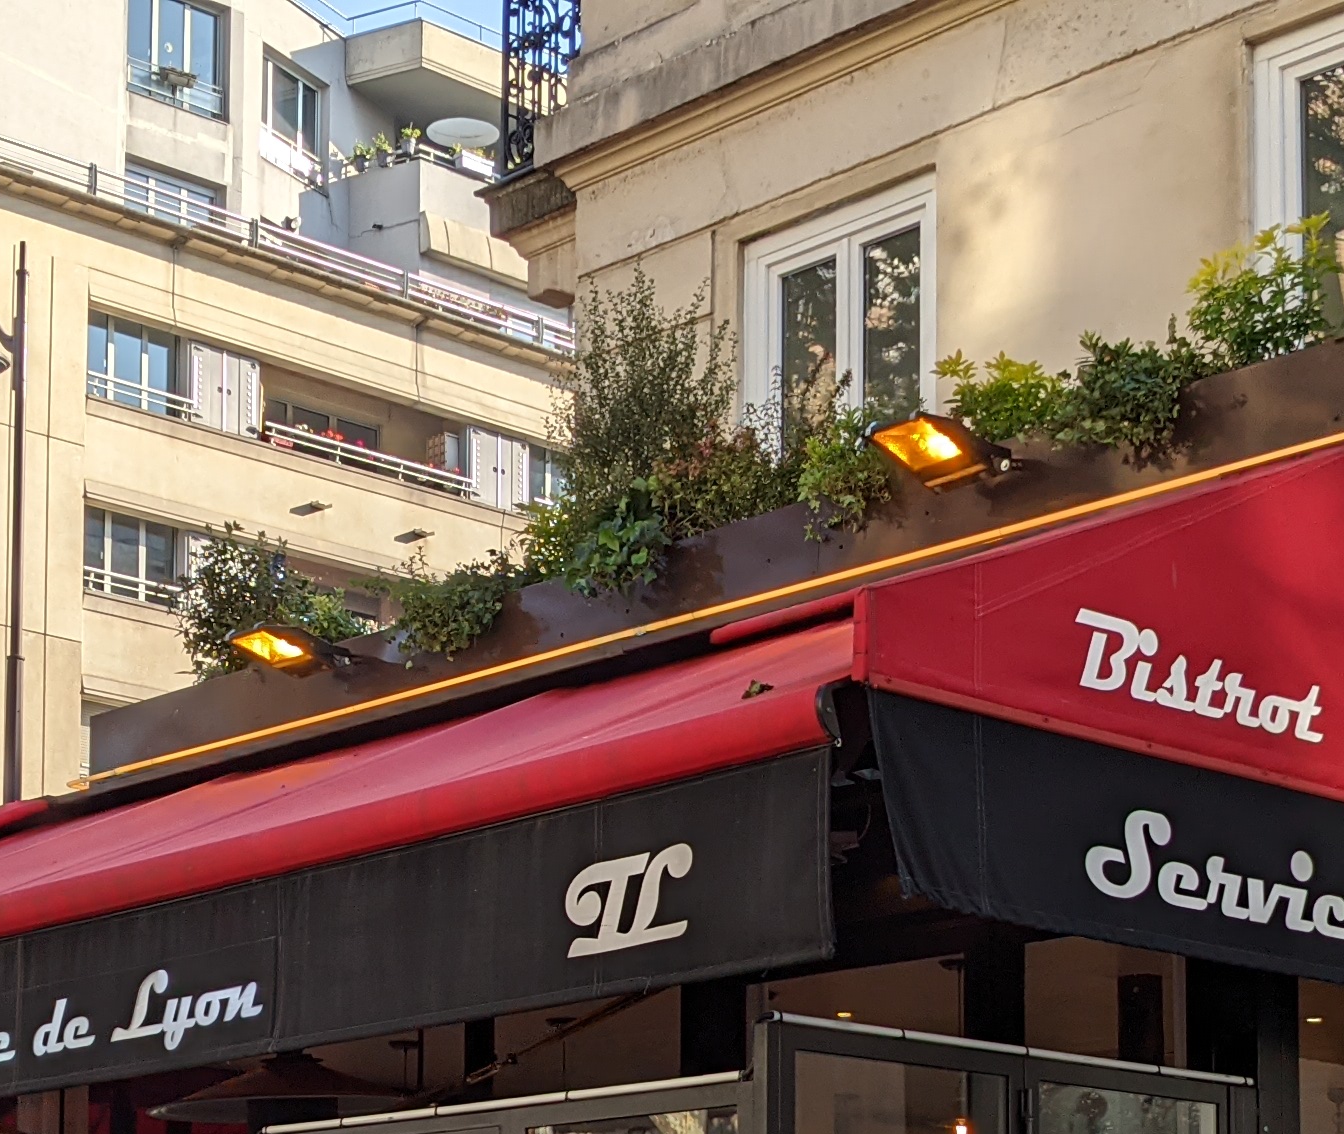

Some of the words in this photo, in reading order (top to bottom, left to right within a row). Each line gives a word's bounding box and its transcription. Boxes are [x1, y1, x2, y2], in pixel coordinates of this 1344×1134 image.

[1074, 607, 1324, 743] Bistrot
[32, 998, 96, 1058] de
[109, 968, 264, 1052] Lyon
